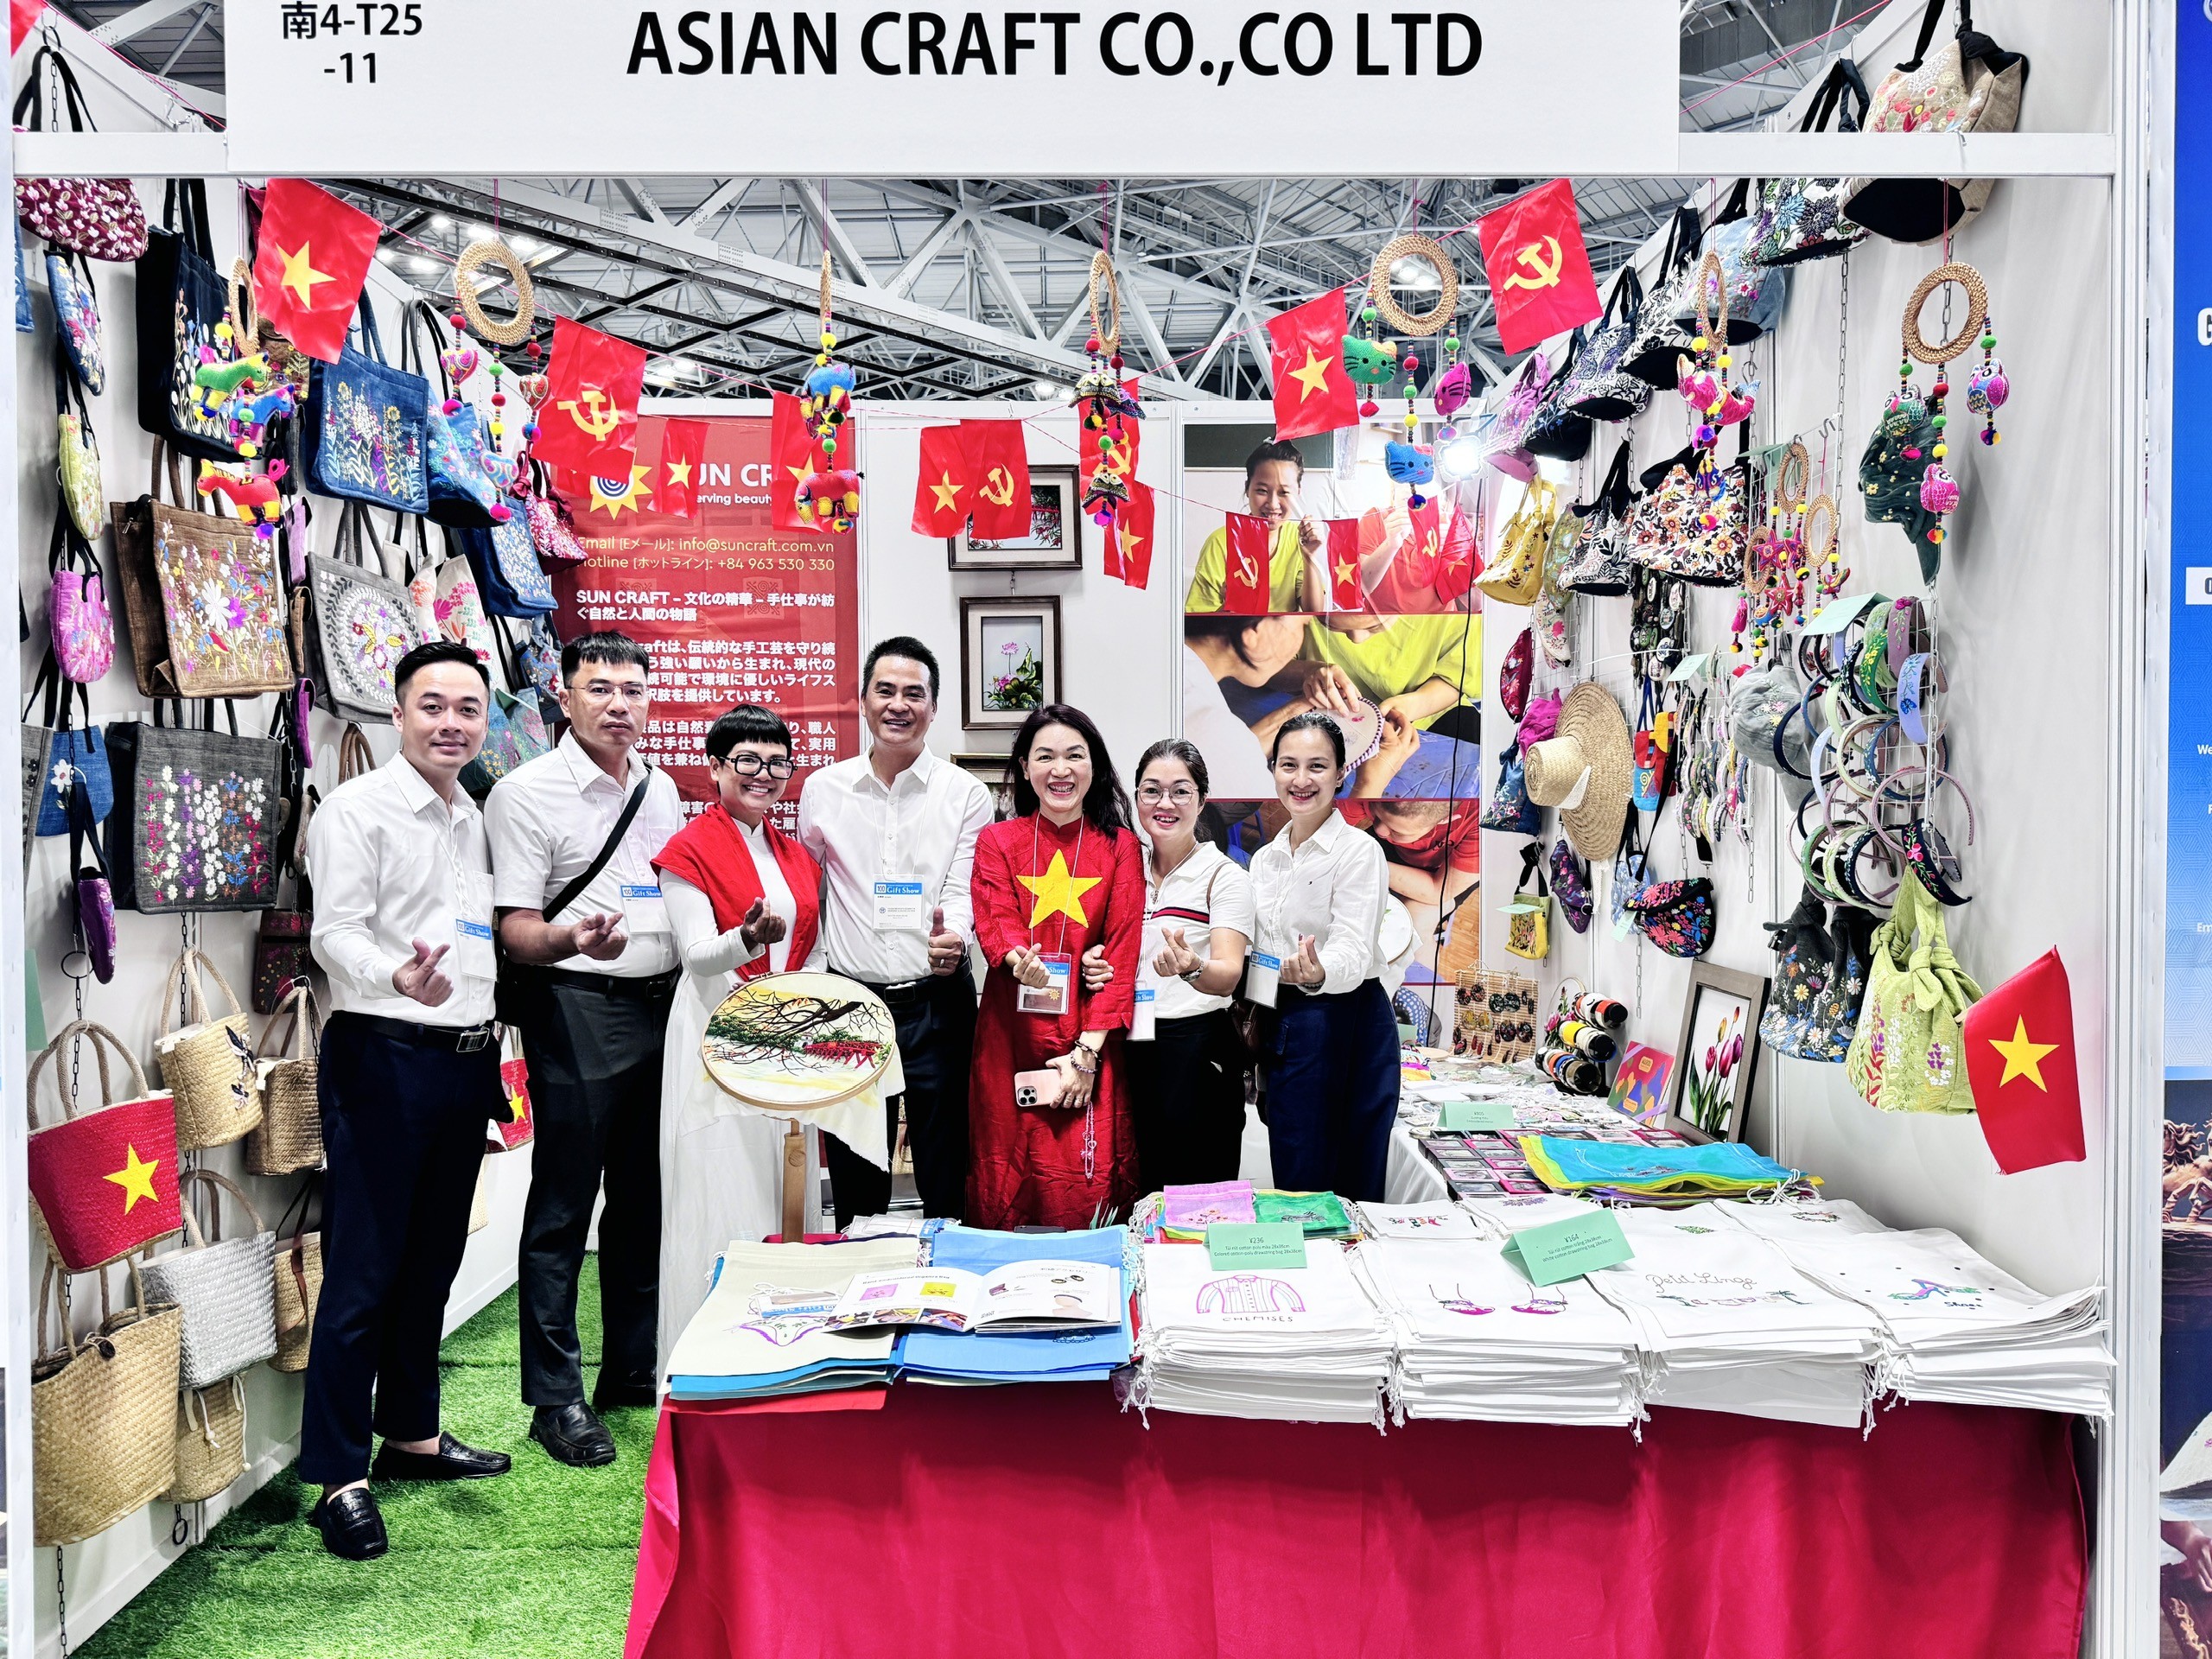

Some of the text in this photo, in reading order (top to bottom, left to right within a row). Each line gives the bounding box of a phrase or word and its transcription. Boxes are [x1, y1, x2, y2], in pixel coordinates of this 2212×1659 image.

[282, 2, 423, 40] 南4-T25
[626, 11, 1483, 86] ASIAN CRAFT CO.,CO LTD
[323, 53, 378, 84] -11
[696, 493, 731, 506] erving
[679, 537, 834, 553] info@suncraft.com.vn
[718, 558, 744, 569] +84
[748, 558, 774, 570] 963
[779, 559, 804, 570] 530
[809, 559, 835, 571] 330
[576, 590, 611, 604] SUN
[614, 590, 670, 605] CRAFT
[1644, 1272, 1758, 1294] Petit Linge
